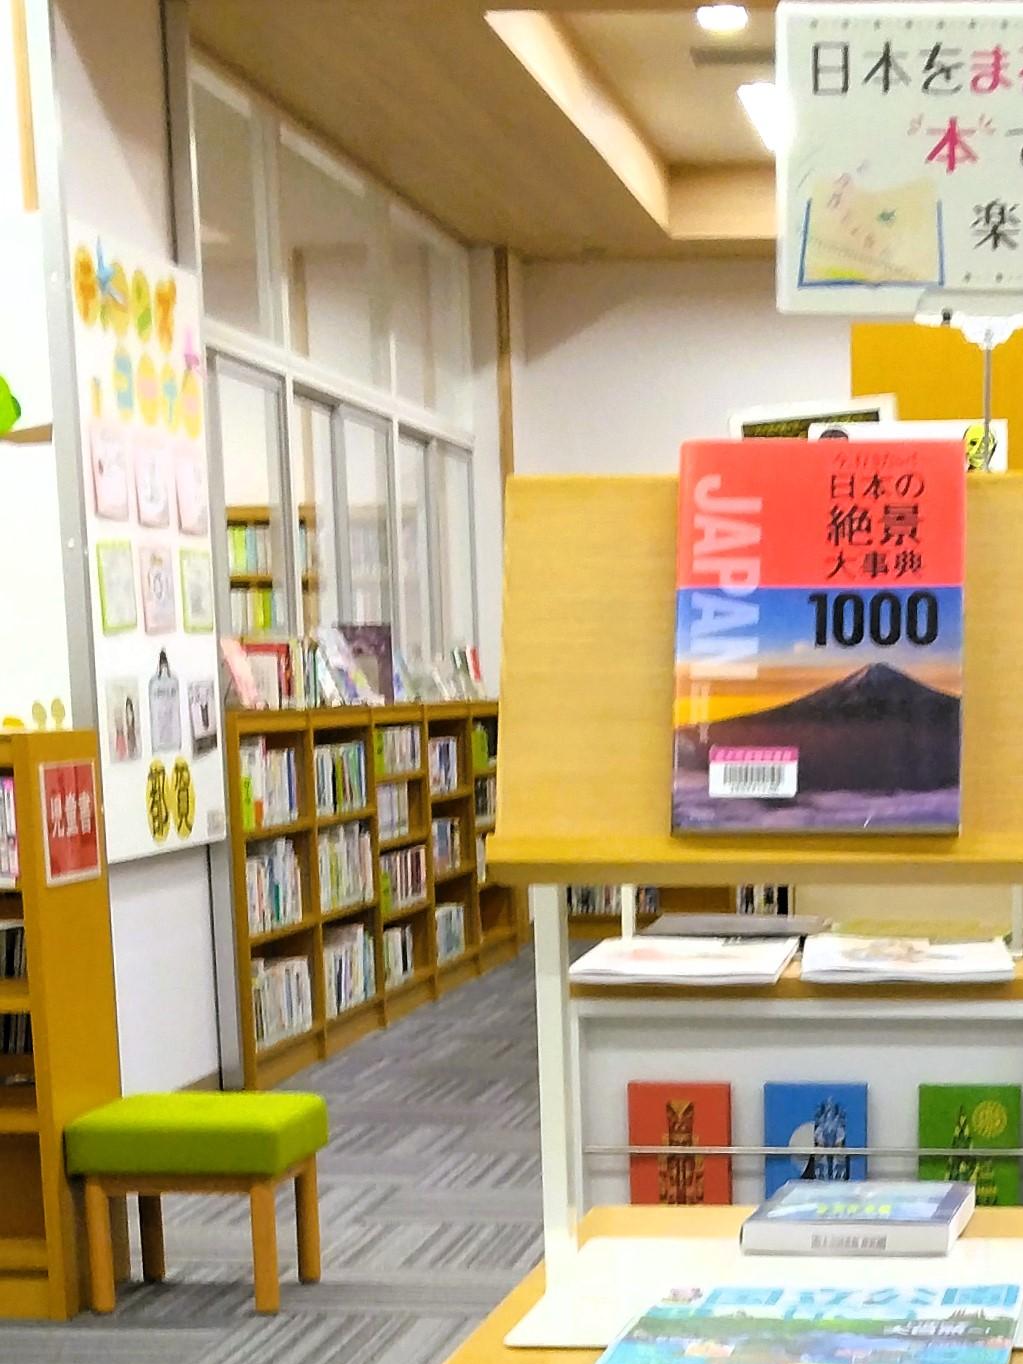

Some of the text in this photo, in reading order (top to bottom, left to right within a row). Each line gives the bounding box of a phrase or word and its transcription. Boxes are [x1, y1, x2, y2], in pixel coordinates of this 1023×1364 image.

[829, 472, 926, 500] 日本の
[827, 503, 921, 547] 絶景
[689, 473, 763, 681] JAPAN
[826, 550, 923, 581] 大事典
[808, 590, 939, 648] 1000
